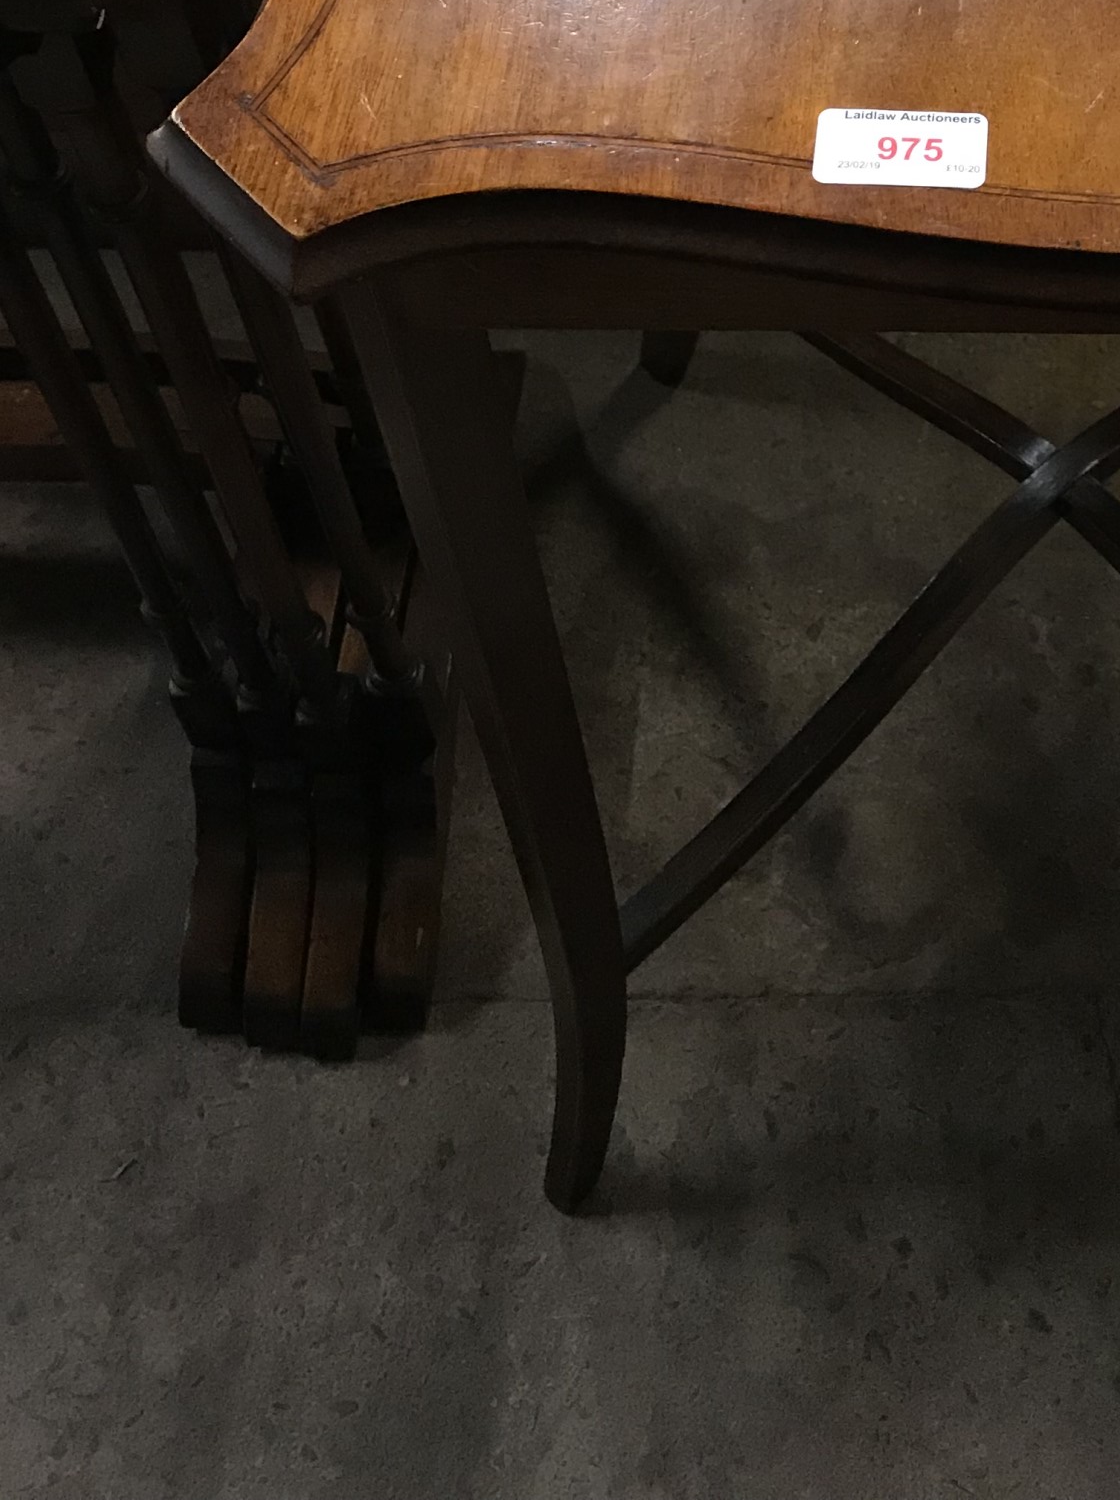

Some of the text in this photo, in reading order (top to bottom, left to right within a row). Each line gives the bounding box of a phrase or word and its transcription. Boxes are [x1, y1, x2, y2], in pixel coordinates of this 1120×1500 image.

[845, 110, 981, 124] Laidlaw Auctioneers
[877, 137, 944, 162] 975
[837, 160, 881, 169] 23/02/19
